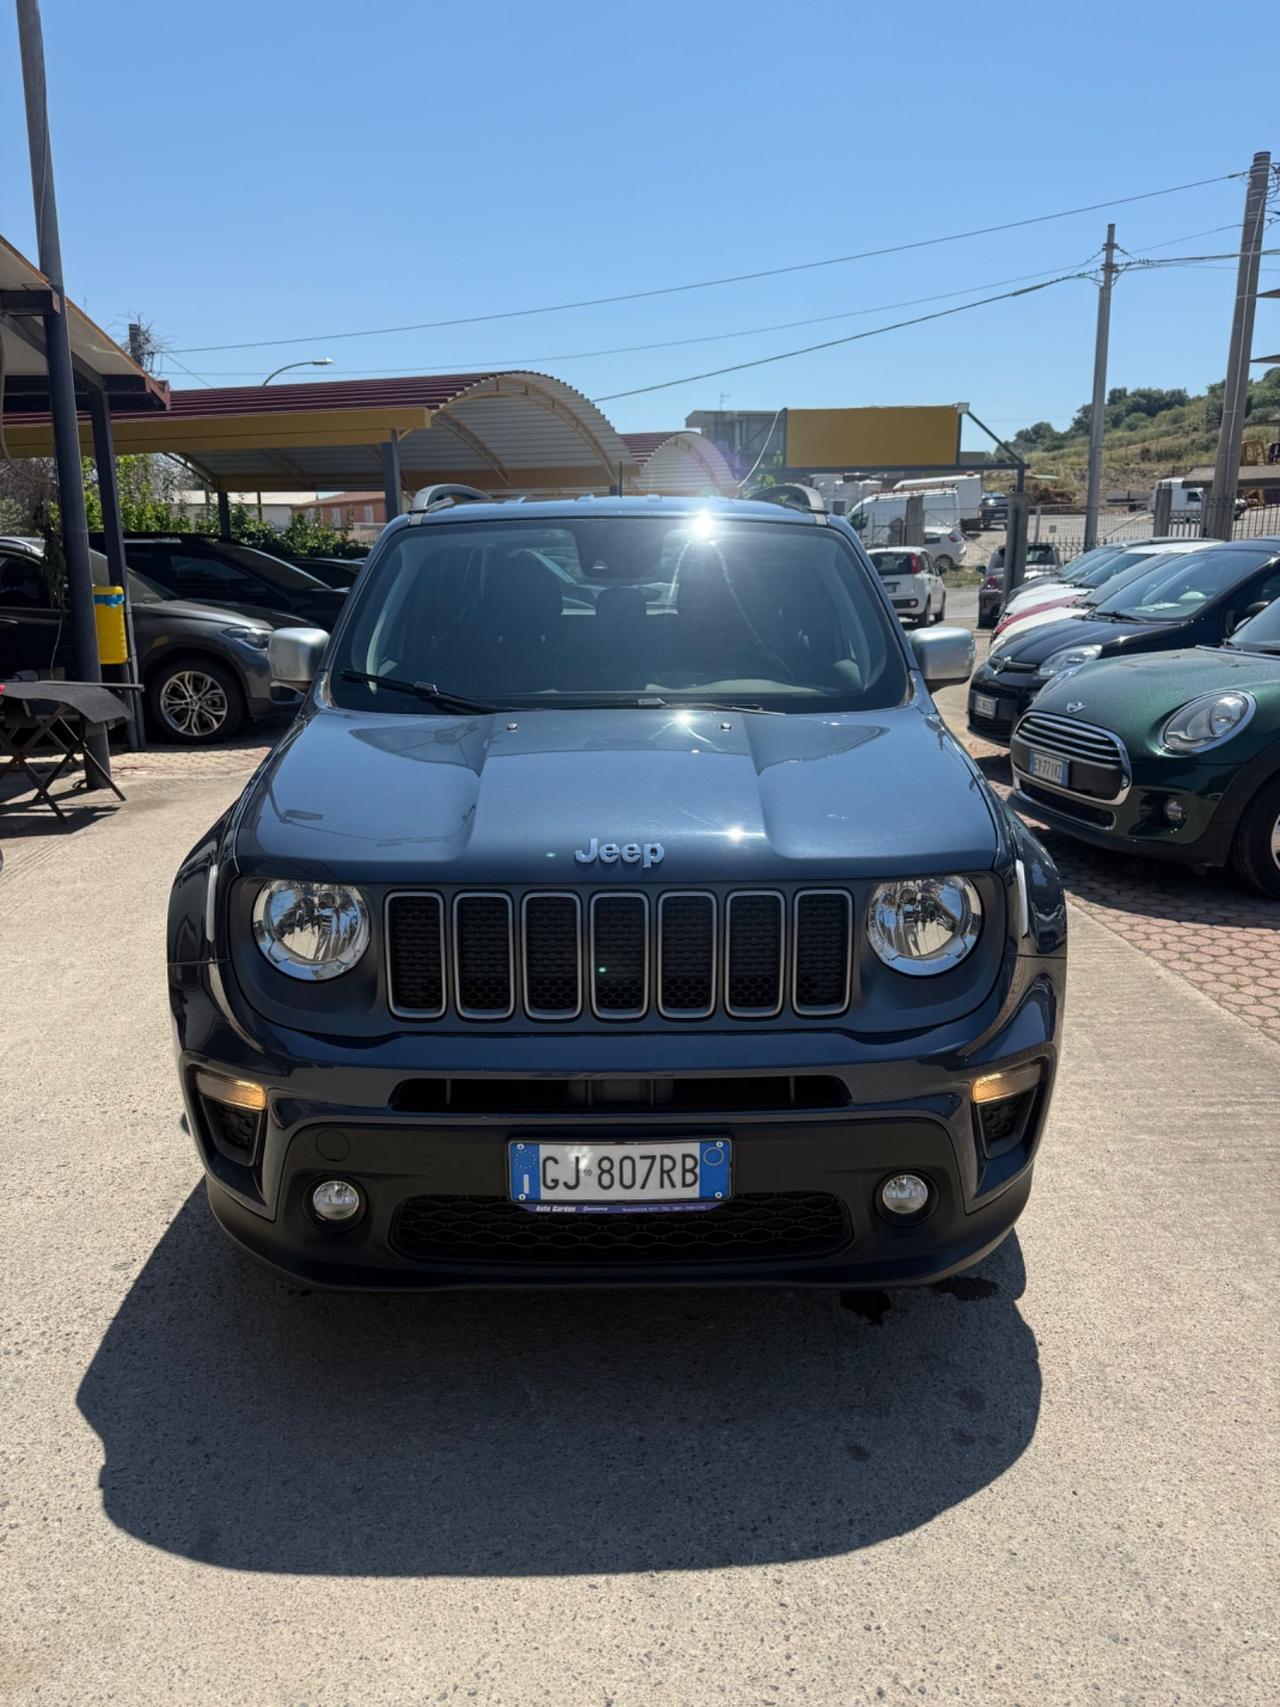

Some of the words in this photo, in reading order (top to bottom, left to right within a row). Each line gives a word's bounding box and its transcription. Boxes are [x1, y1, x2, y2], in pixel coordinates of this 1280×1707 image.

[574, 837, 664, 868] Jeep
[542, 1156, 580, 1190] GJ
[597, 1154, 699, 1190] 807RB
